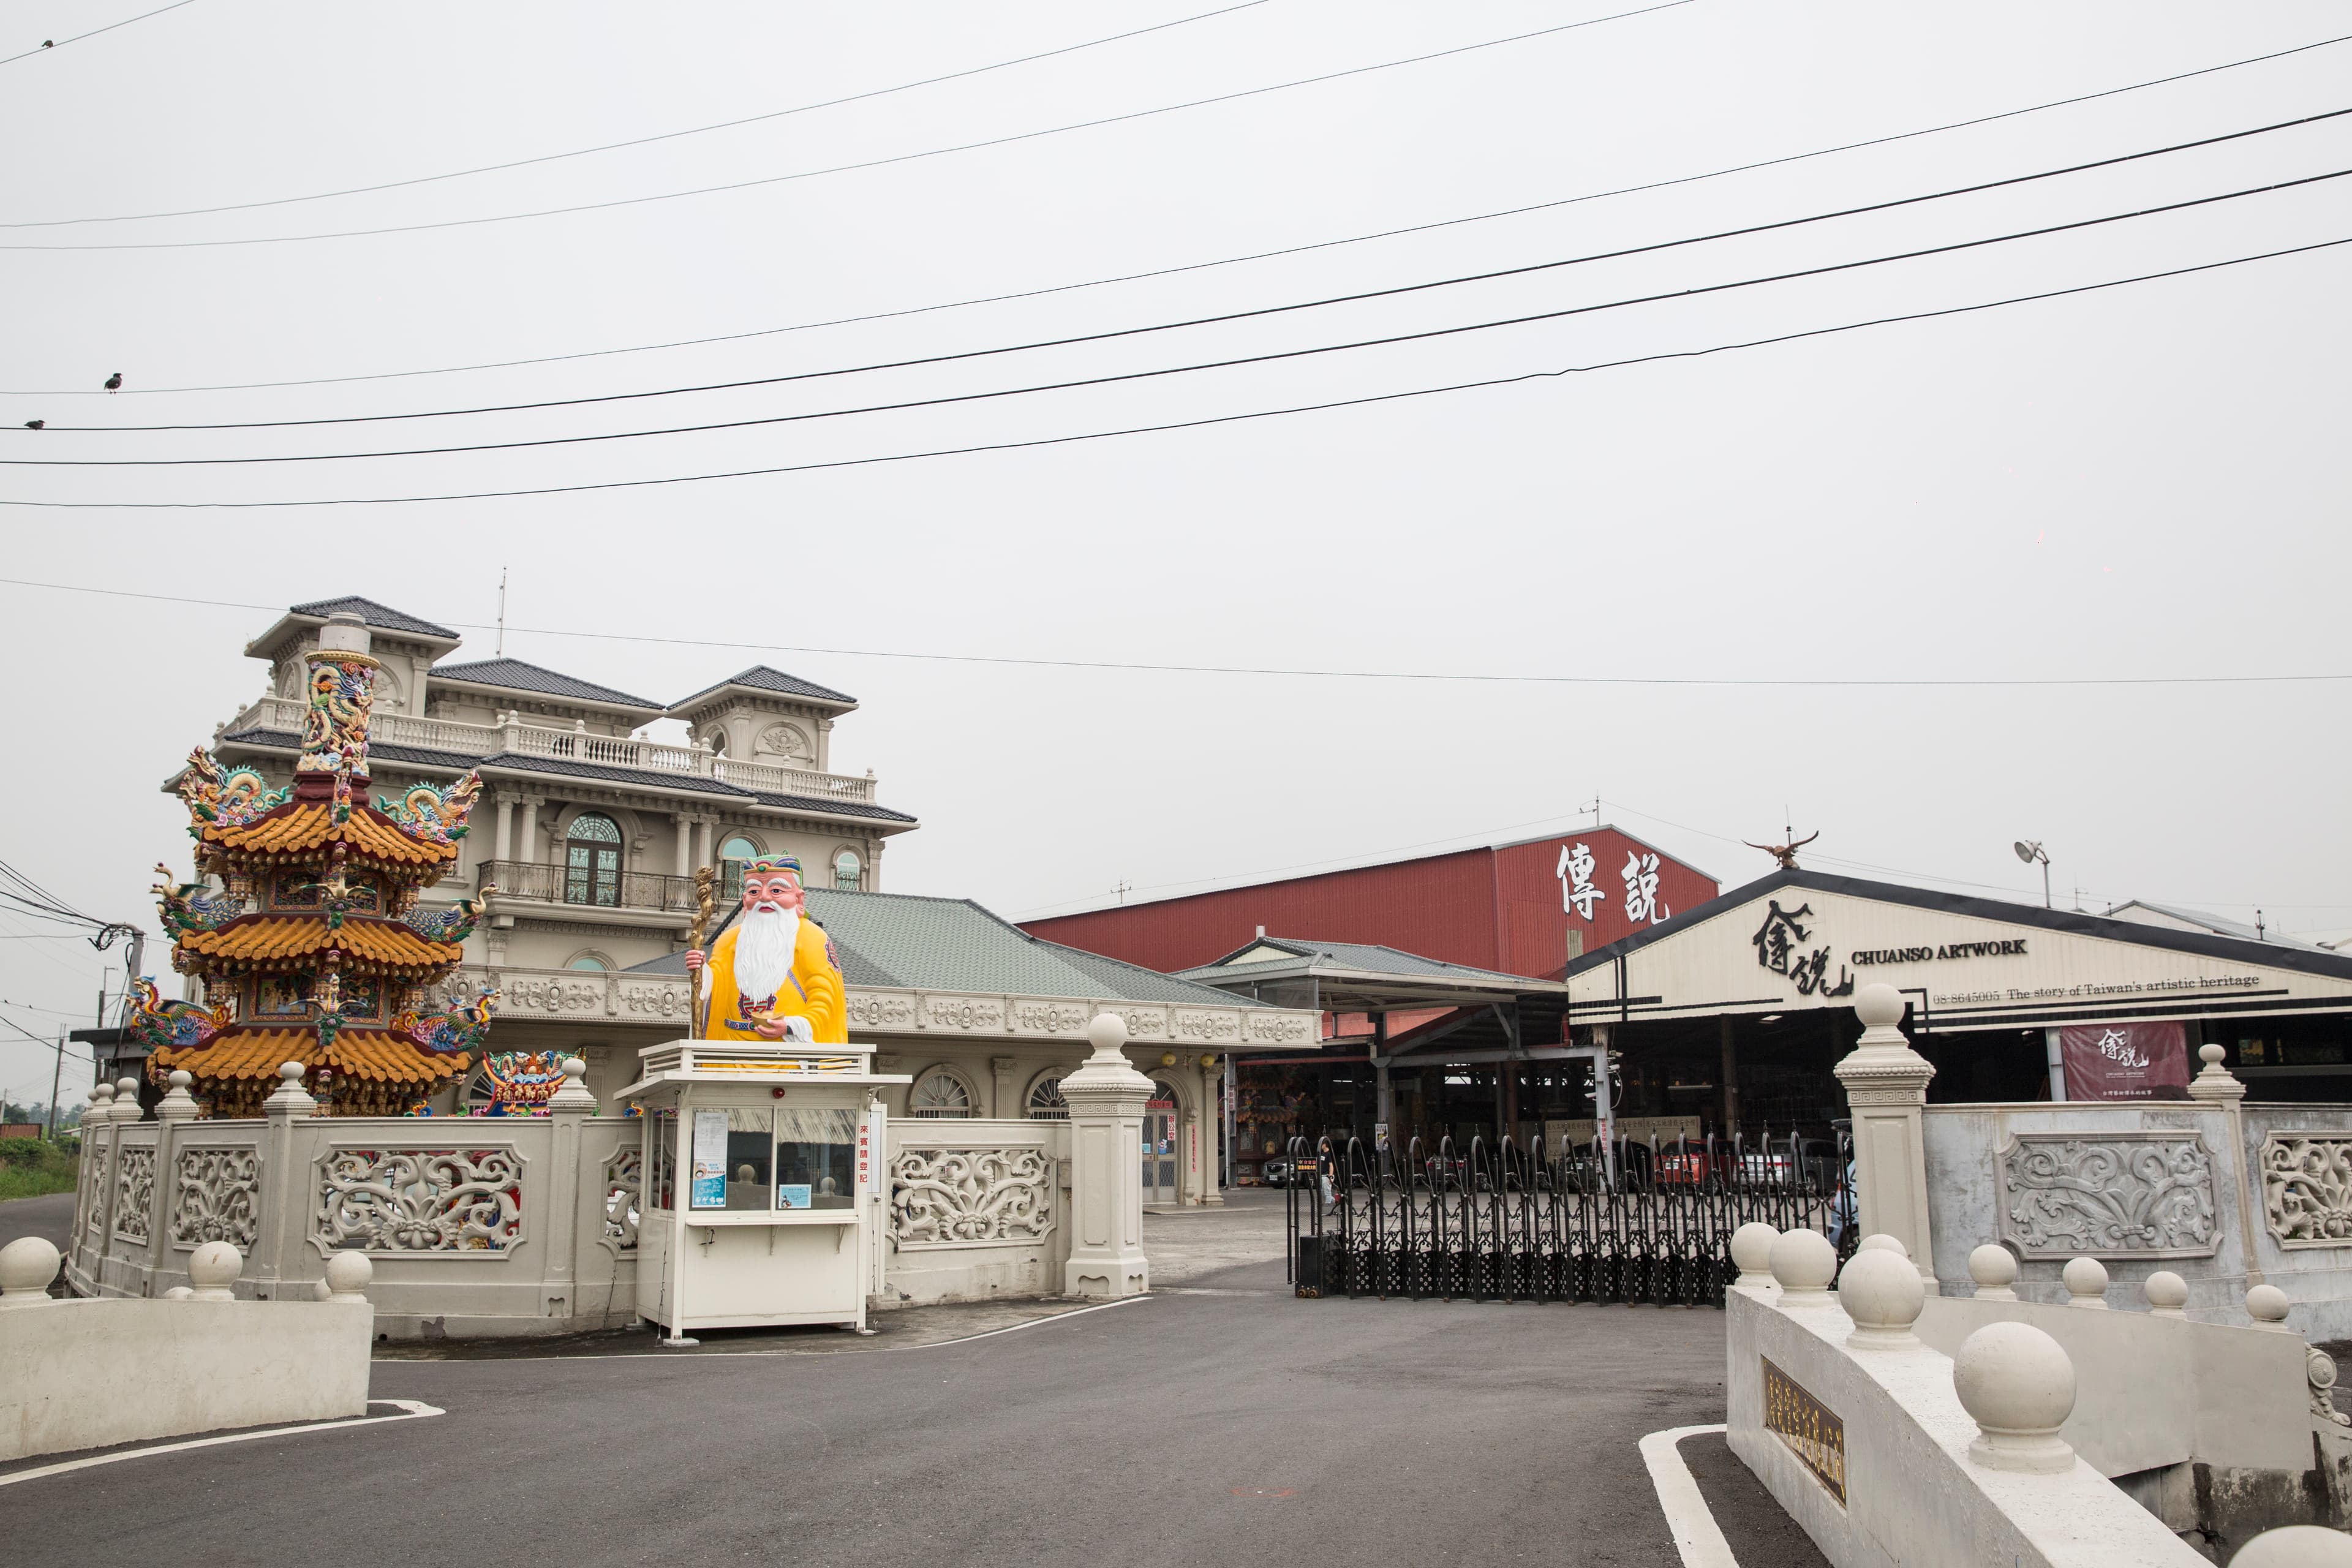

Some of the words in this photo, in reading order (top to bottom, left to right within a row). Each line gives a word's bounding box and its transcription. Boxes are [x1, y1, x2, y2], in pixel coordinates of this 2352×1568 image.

[1851, 946, 1933, 965] CHUANSO
[1936, 939, 2028, 960] ARTWORK
[1932, 992, 2000, 1005] 08-8645005
[2007, 988, 2030, 1000] The
[2034, 986, 2065, 998] story
[2069, 985, 2081, 997] of
[2084, 981, 2143, 995] Taiwan's
[2146, 977, 2195, 992] artistic
[2199, 974, 2260, 988] heritage
[859, 1125, 868, 1183] 來賓請登記
